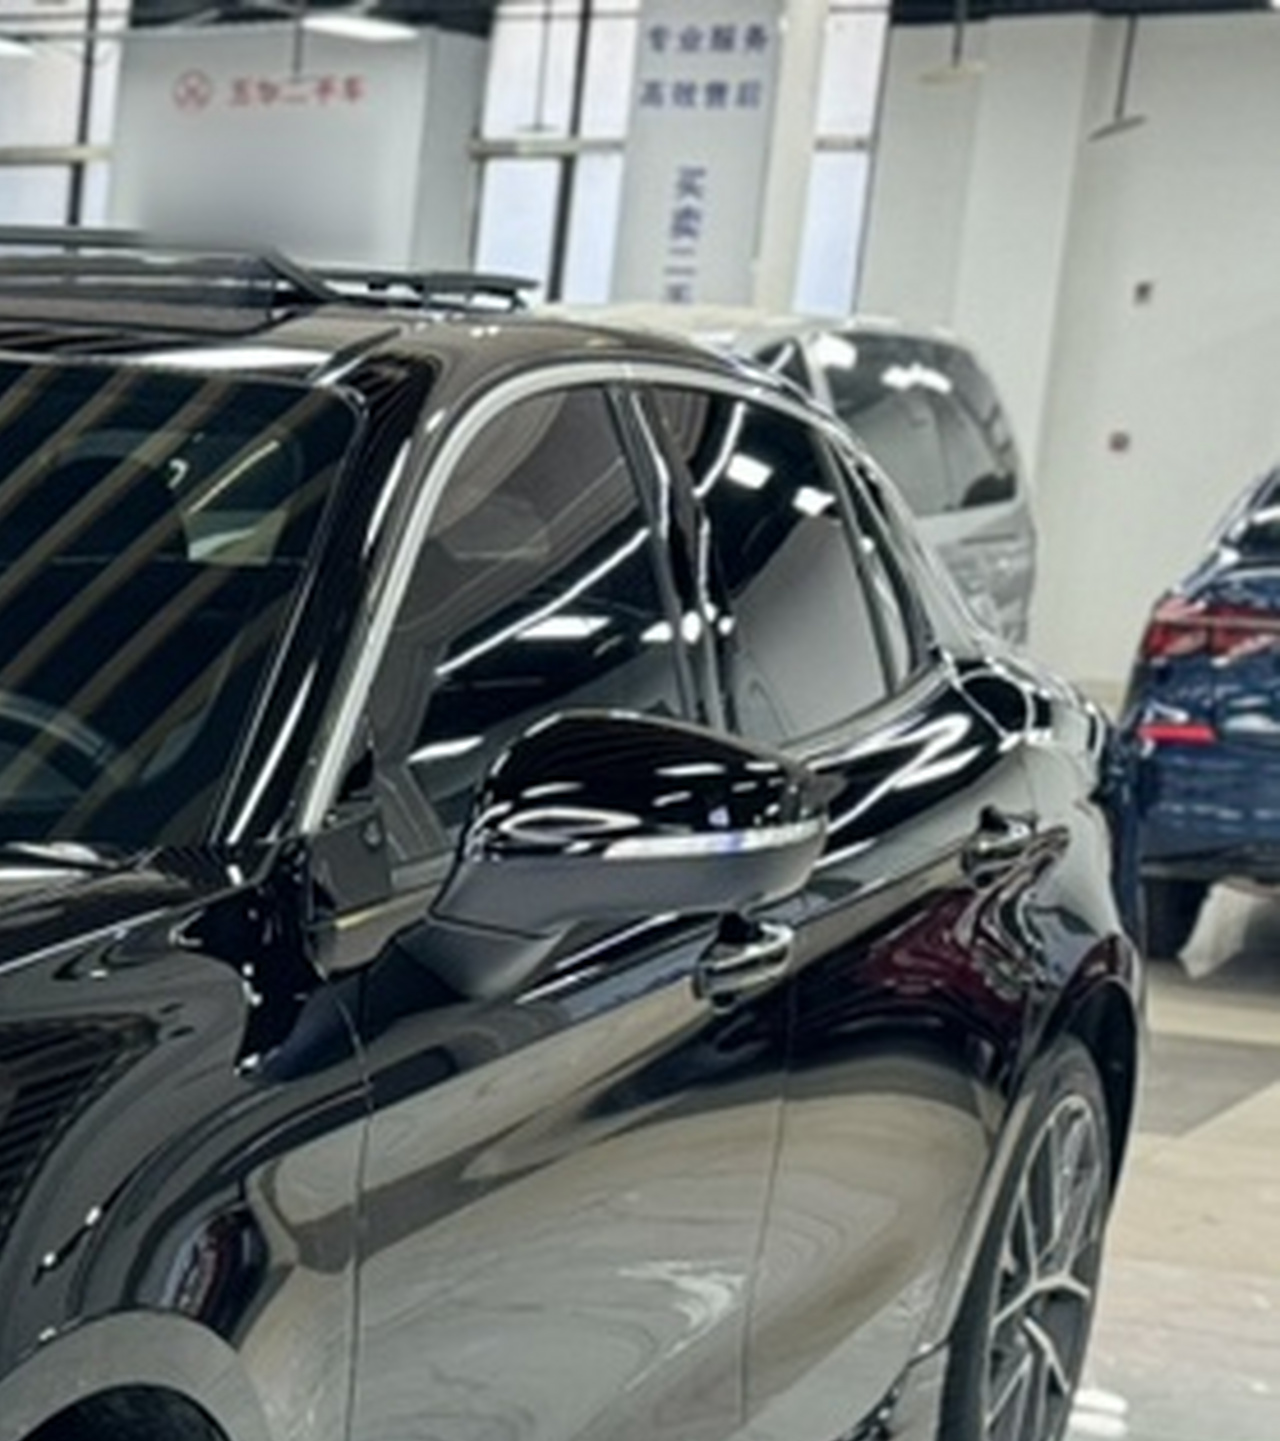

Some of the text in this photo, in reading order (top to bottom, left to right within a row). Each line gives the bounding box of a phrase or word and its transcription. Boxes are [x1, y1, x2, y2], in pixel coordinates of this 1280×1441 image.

[649, 23, 768, 54] 专业服务
[640, 79, 761, 110] 高效售后
